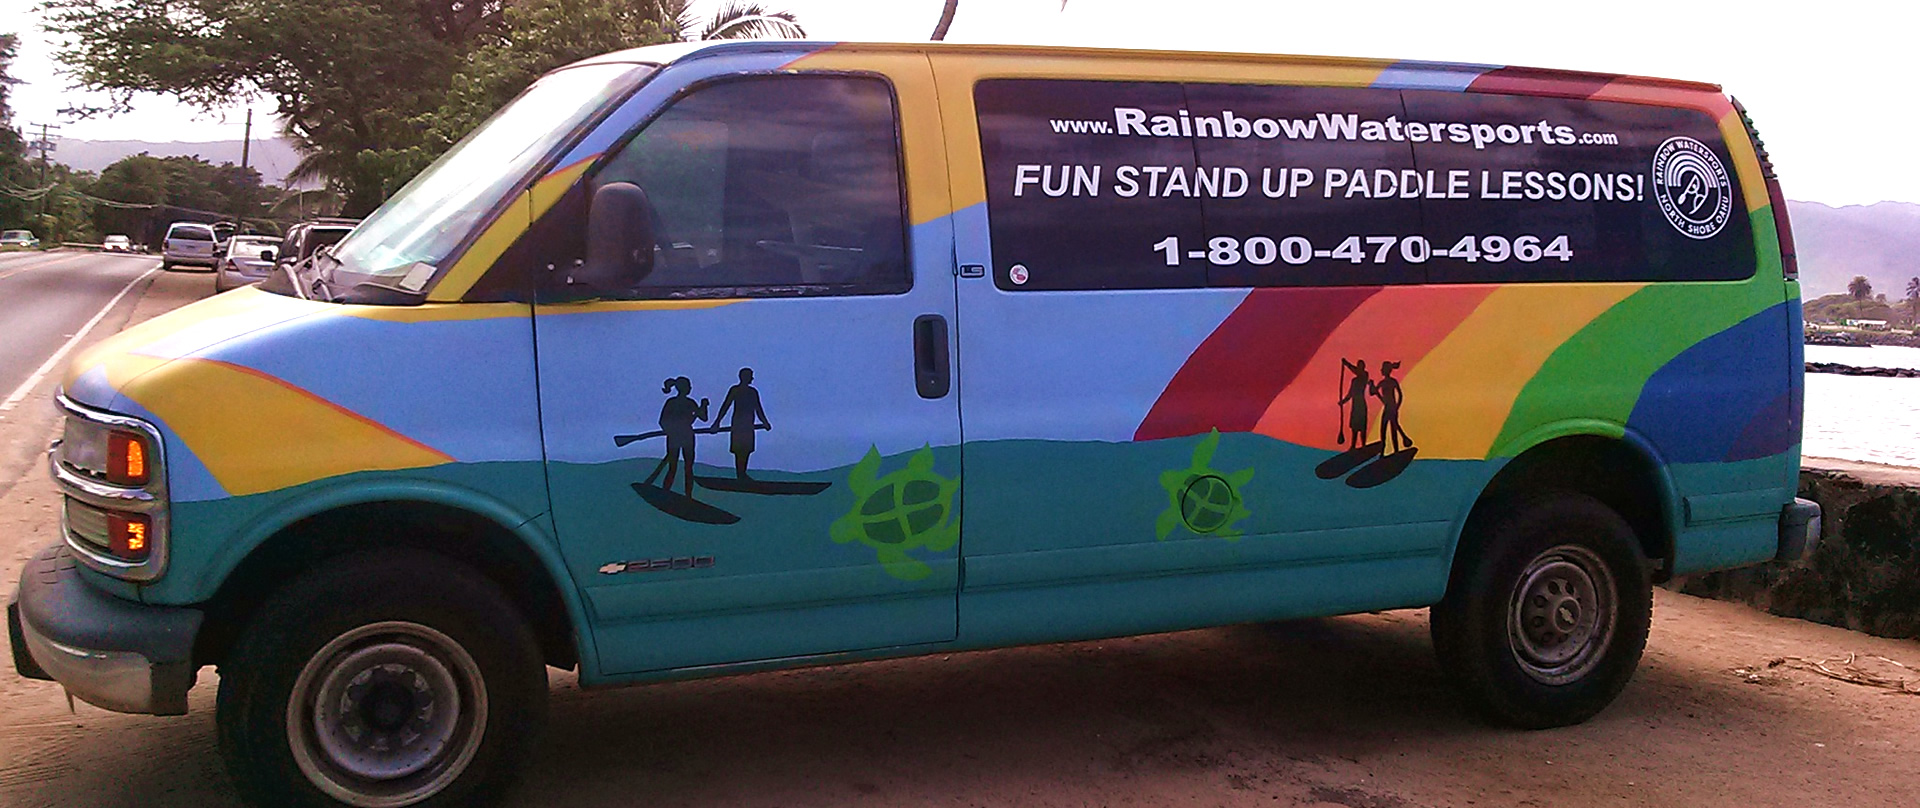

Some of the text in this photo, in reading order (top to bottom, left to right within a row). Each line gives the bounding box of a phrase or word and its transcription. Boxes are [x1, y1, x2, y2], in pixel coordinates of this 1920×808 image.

[1050, 107, 1619, 150] www.RainbowWatersports.com
[1013, 165, 1644, 201] FUN STAND UP PADDLE LESSONS!
[1656, 141, 1728, 187] RAINBOW WATERSPORTS
[1660, 194, 1729, 234] NORTH SHORE OAHU
[1153, 234, 1574, 266] 1-800-470-4964
